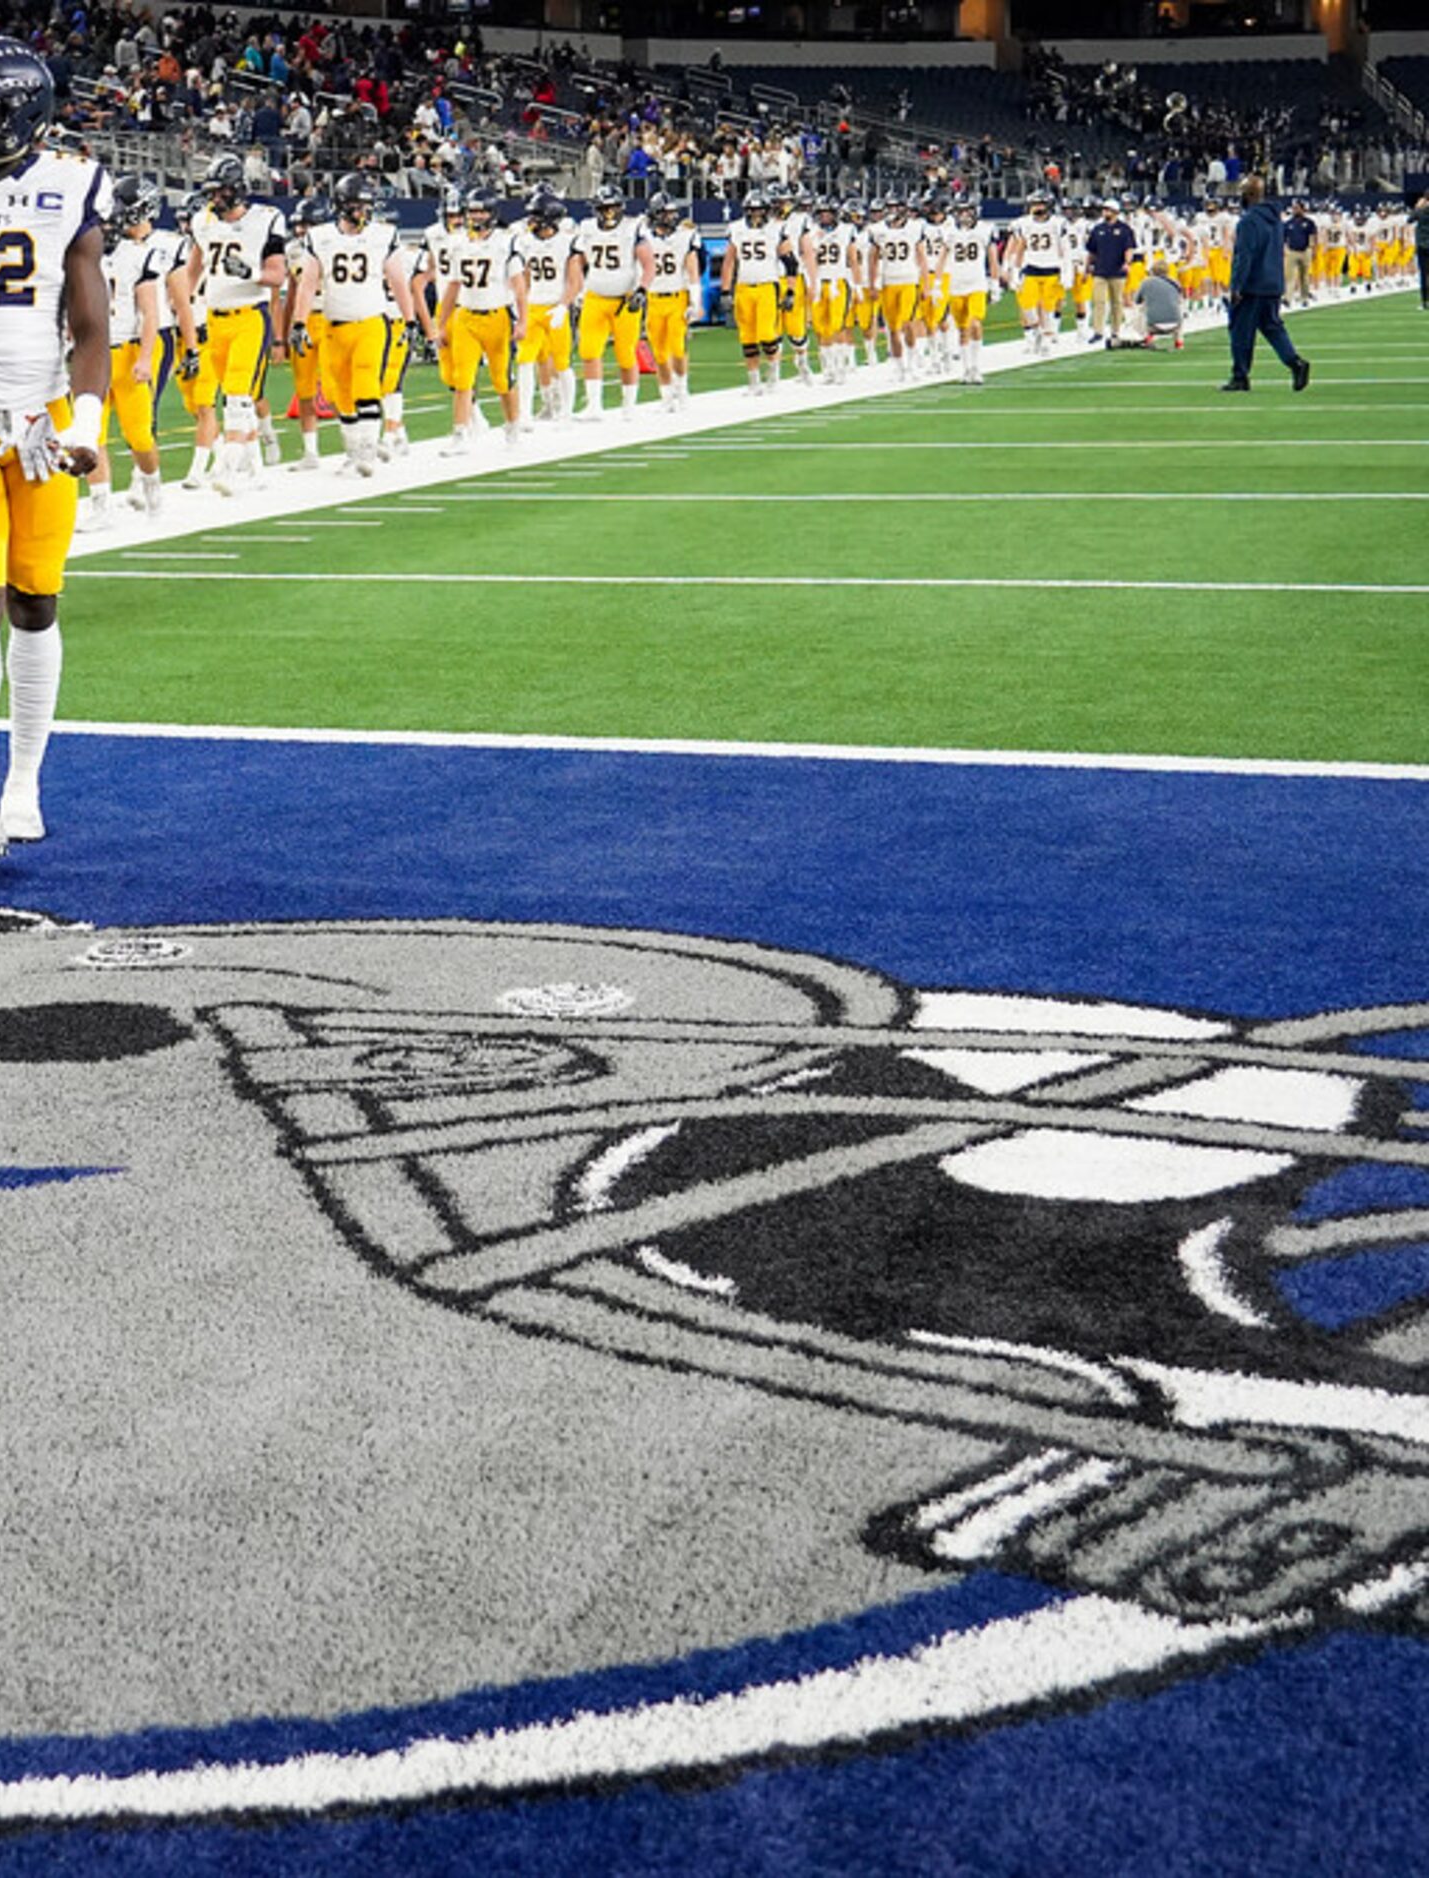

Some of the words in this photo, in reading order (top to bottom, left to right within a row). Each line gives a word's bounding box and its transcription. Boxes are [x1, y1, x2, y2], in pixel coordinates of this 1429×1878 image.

[741, 241, 766, 260] 55
[885, 242, 910, 261] 33
[1030, 233, 1051, 251] 23
[332, 253, 368, 284] 63
[529, 256, 556, 281] 96
[592, 245, 620, 270] 75
[460, 259, 491, 288] 57
